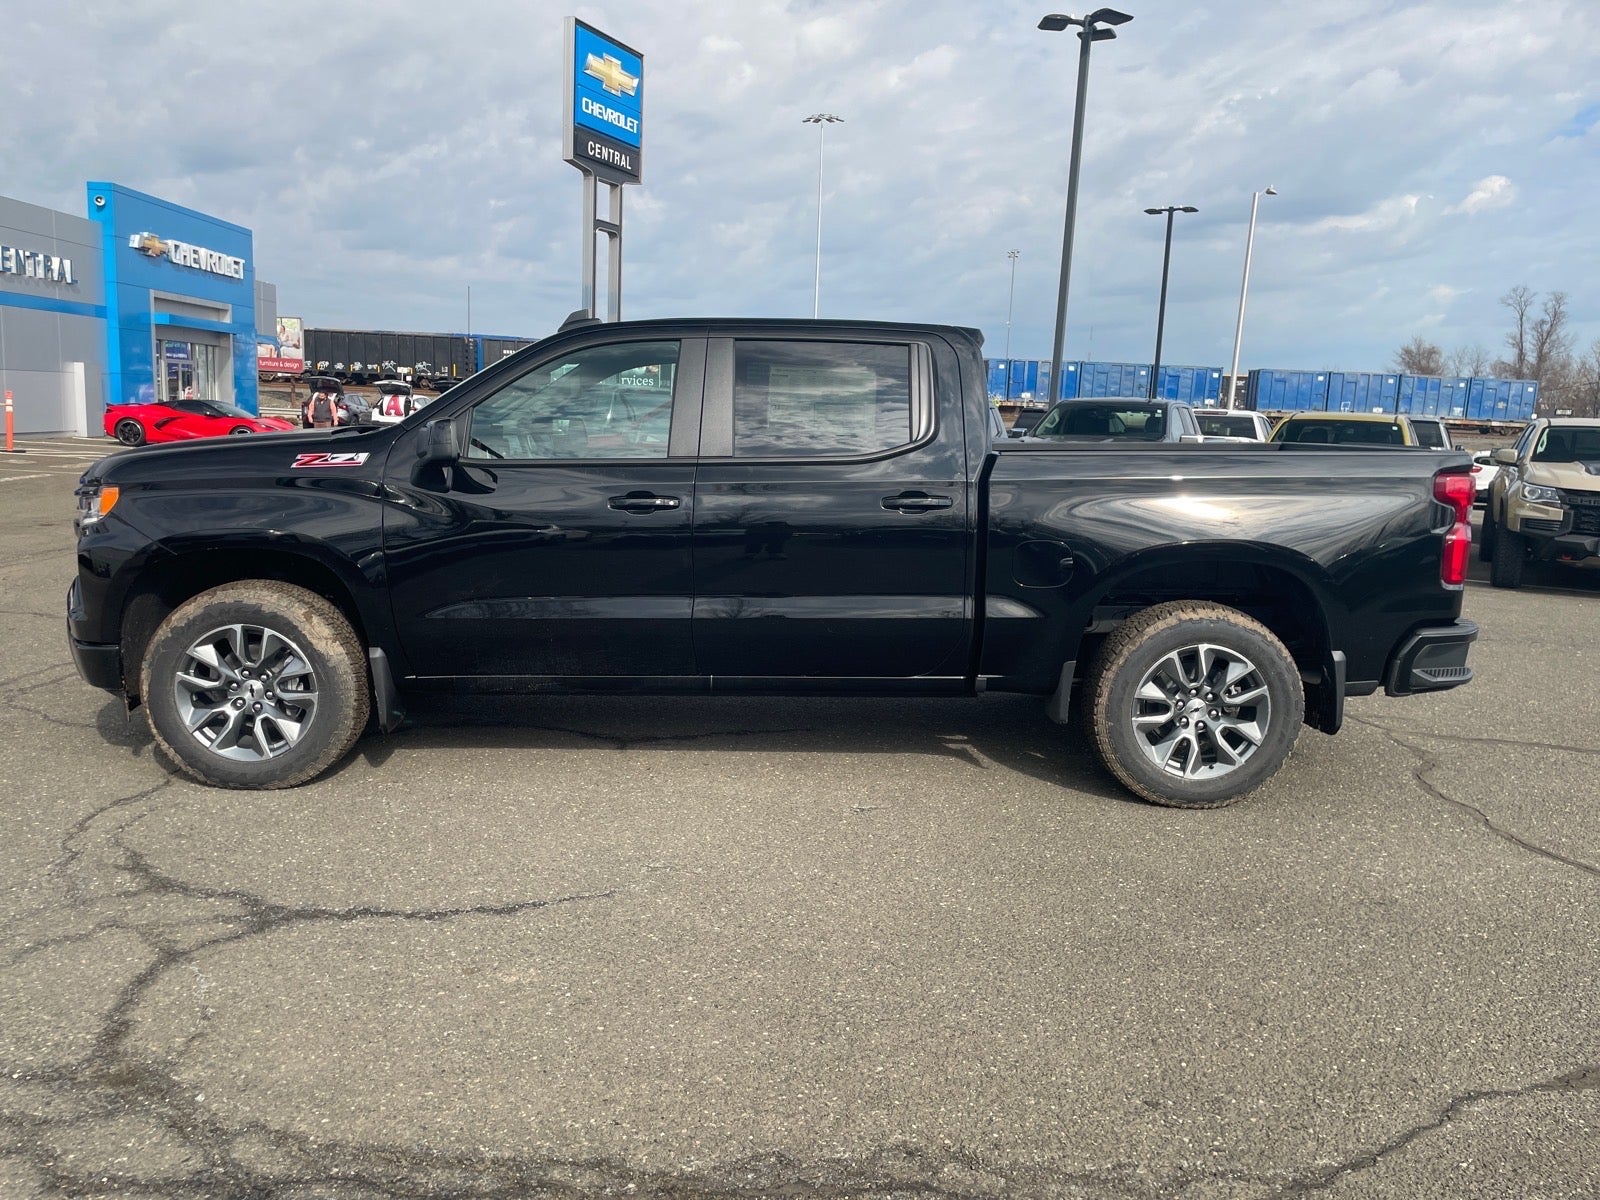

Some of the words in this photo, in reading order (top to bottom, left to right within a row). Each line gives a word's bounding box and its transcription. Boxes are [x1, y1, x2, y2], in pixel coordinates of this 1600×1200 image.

[582, 97, 638, 133] CHEVROLET
[588, 141, 631, 169] CENTRAL
[0, 245, 78, 284] ENTRAL
[167, 239, 245, 279] CHEVROLET
[284, 360, 299, 369] design
[621, 375, 654, 386] rvices
[290, 452, 370, 468] Z71
